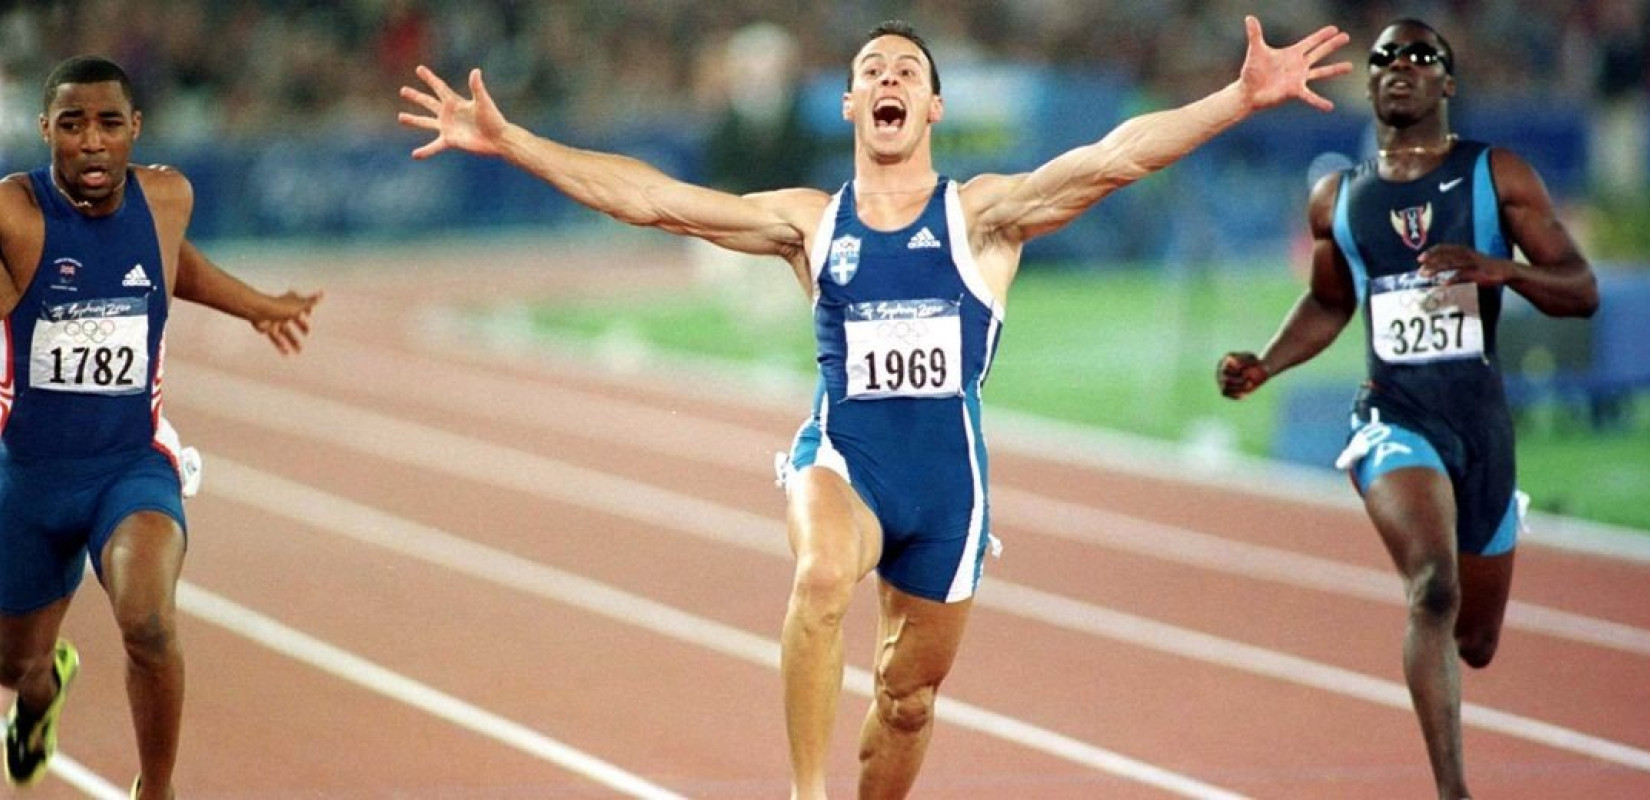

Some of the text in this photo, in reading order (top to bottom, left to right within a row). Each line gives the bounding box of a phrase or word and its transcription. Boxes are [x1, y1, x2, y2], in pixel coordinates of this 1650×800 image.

[1389, 311, 1465, 356] 3257
[50, 345, 134, 387] 1782
[864, 347, 947, 391] 1969
